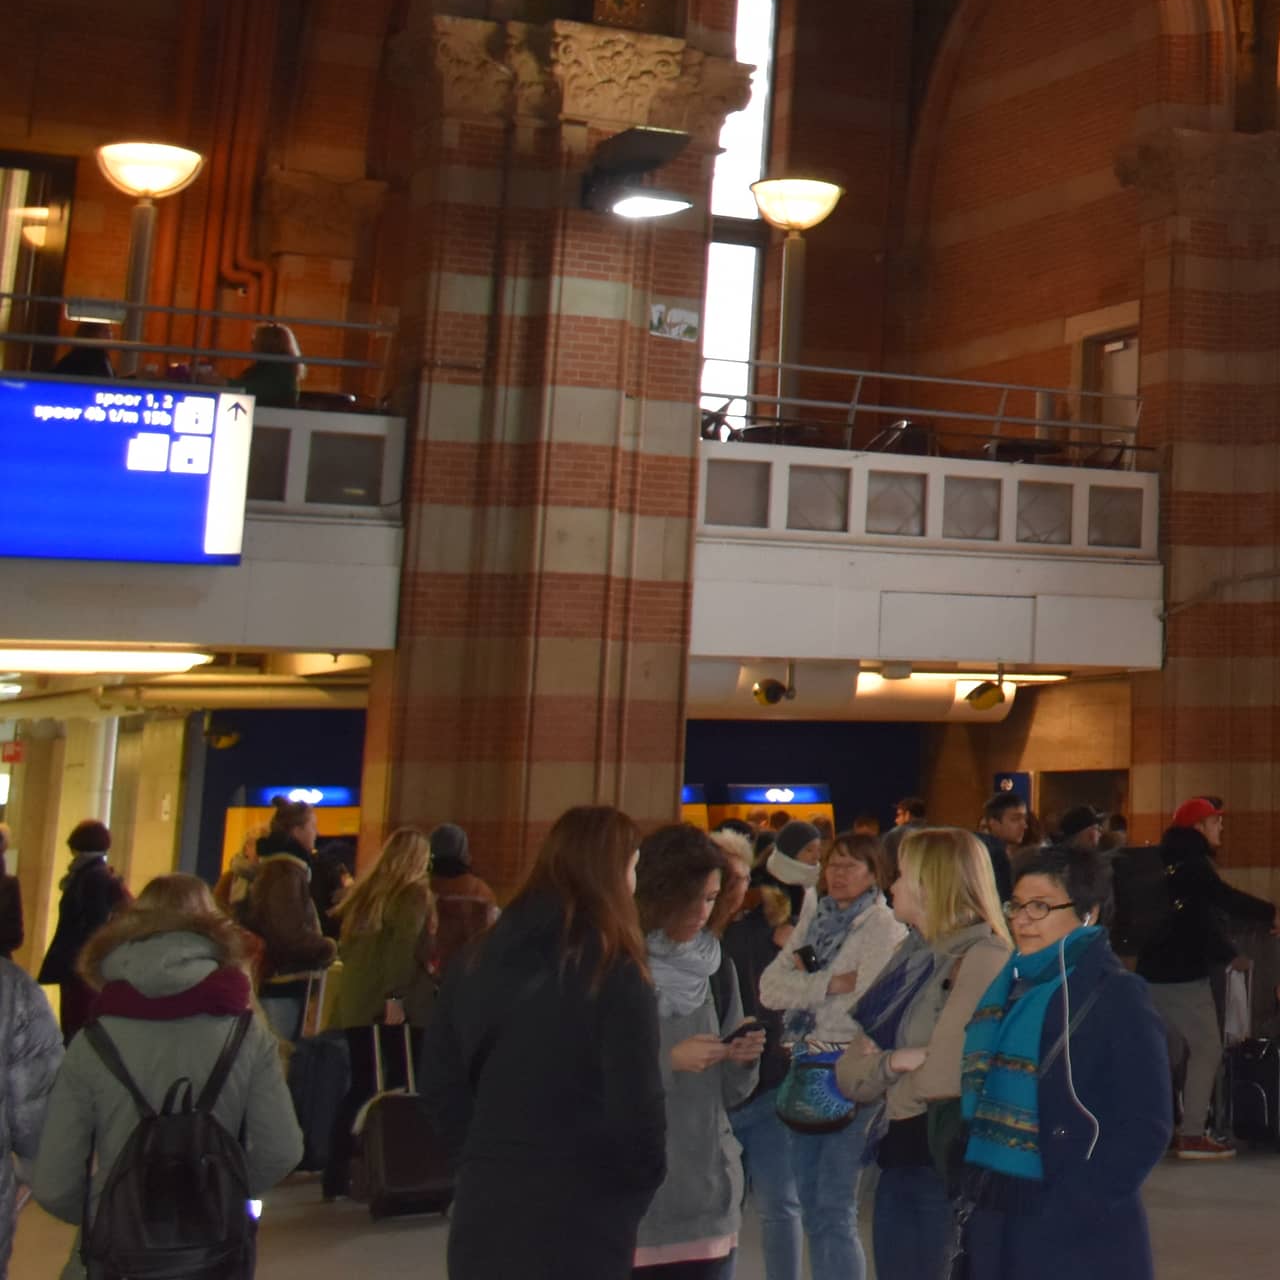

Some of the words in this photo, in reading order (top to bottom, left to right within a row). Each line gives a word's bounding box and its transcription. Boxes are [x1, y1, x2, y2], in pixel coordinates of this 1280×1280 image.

[96, 393, 141, 407] spoor
[163, 395, 173, 409] 2
[35, 406, 82, 420] spoor
